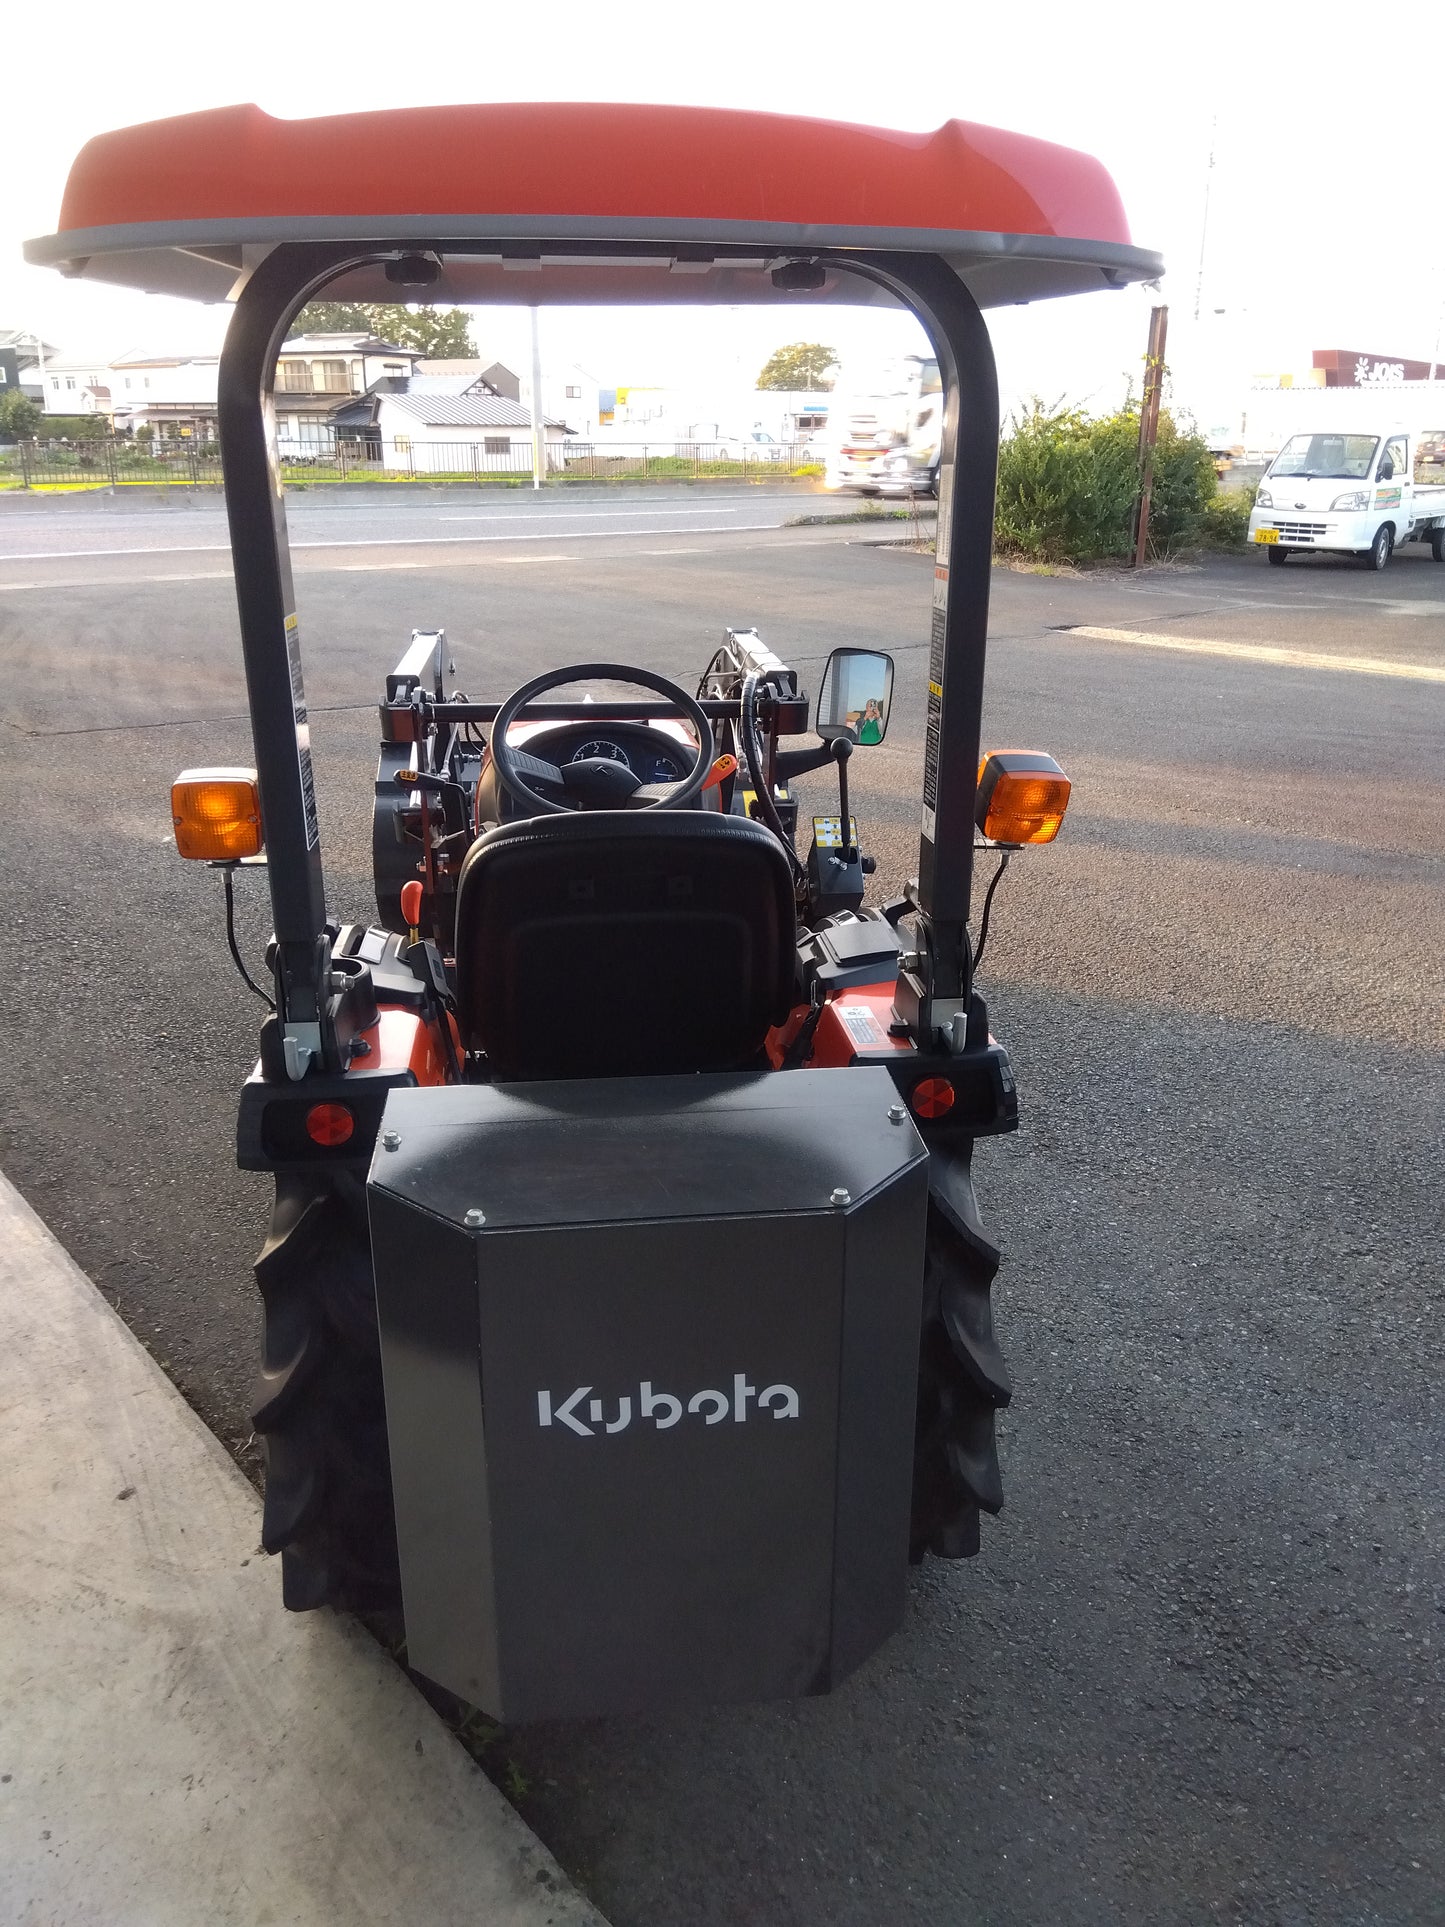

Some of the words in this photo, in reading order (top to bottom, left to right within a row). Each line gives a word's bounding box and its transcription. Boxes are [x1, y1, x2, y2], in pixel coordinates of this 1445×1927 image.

[593, 745, 600, 754] 2
[610, 749, 617, 759] 3
[537, 1373, 799, 1437] Kubota
